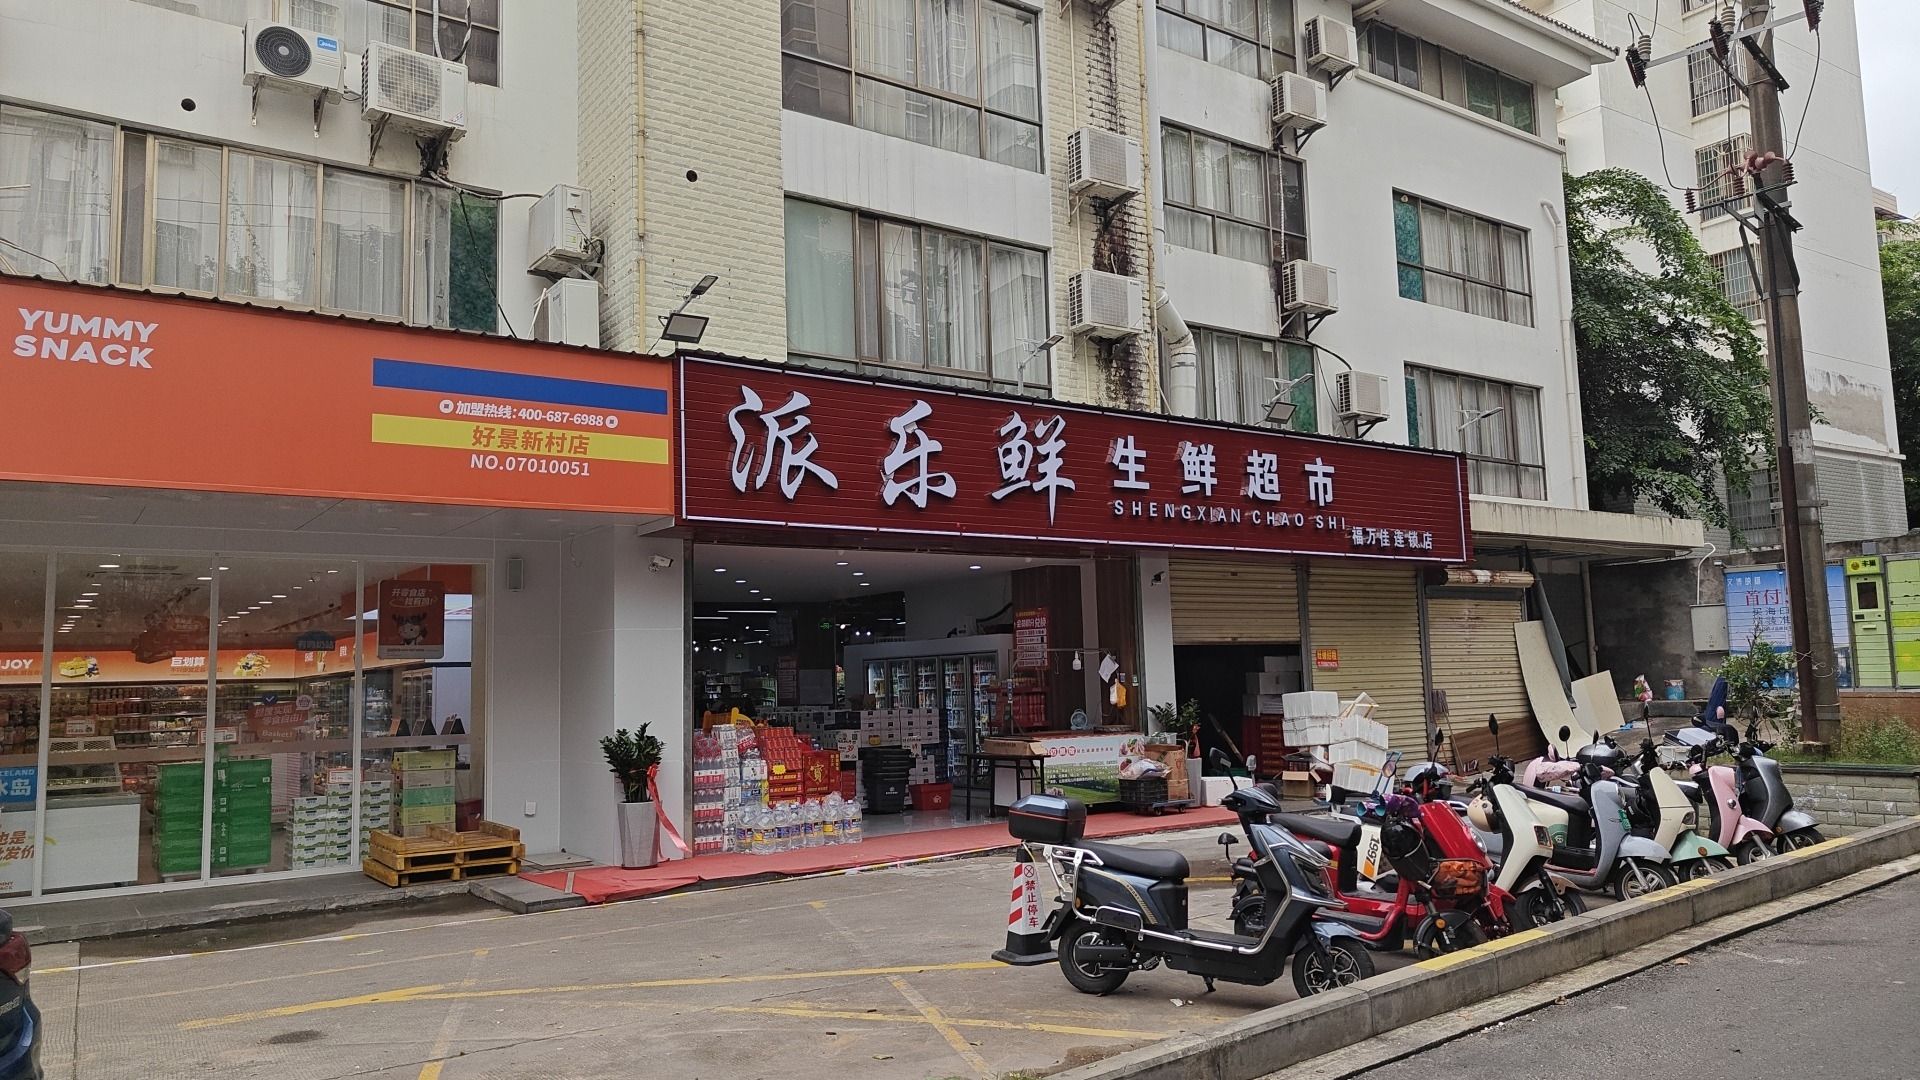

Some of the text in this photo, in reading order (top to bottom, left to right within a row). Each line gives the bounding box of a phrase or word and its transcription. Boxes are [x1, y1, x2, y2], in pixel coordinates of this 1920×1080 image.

[18, 308, 159, 343] YUMMY
[13, 335, 153, 369] SNACK
[471, 425, 591, 456] 好景新村店
[728, 384, 1336, 526] 派乐鲜 生鲜超市
[470, 453, 591, 476] NO.07010051
[1113, 499, 1346, 530] SHENGXIAN CHAO SHI
[1351, 526, 1434, 550] 福万佳连锁店
[1745, 588, 1788, 607] 首付
[0, 845, 34, 860] 发价
[1366, 834, 1380, 866] 1997
[1025, 880, 1039, 928] 禁止停车
